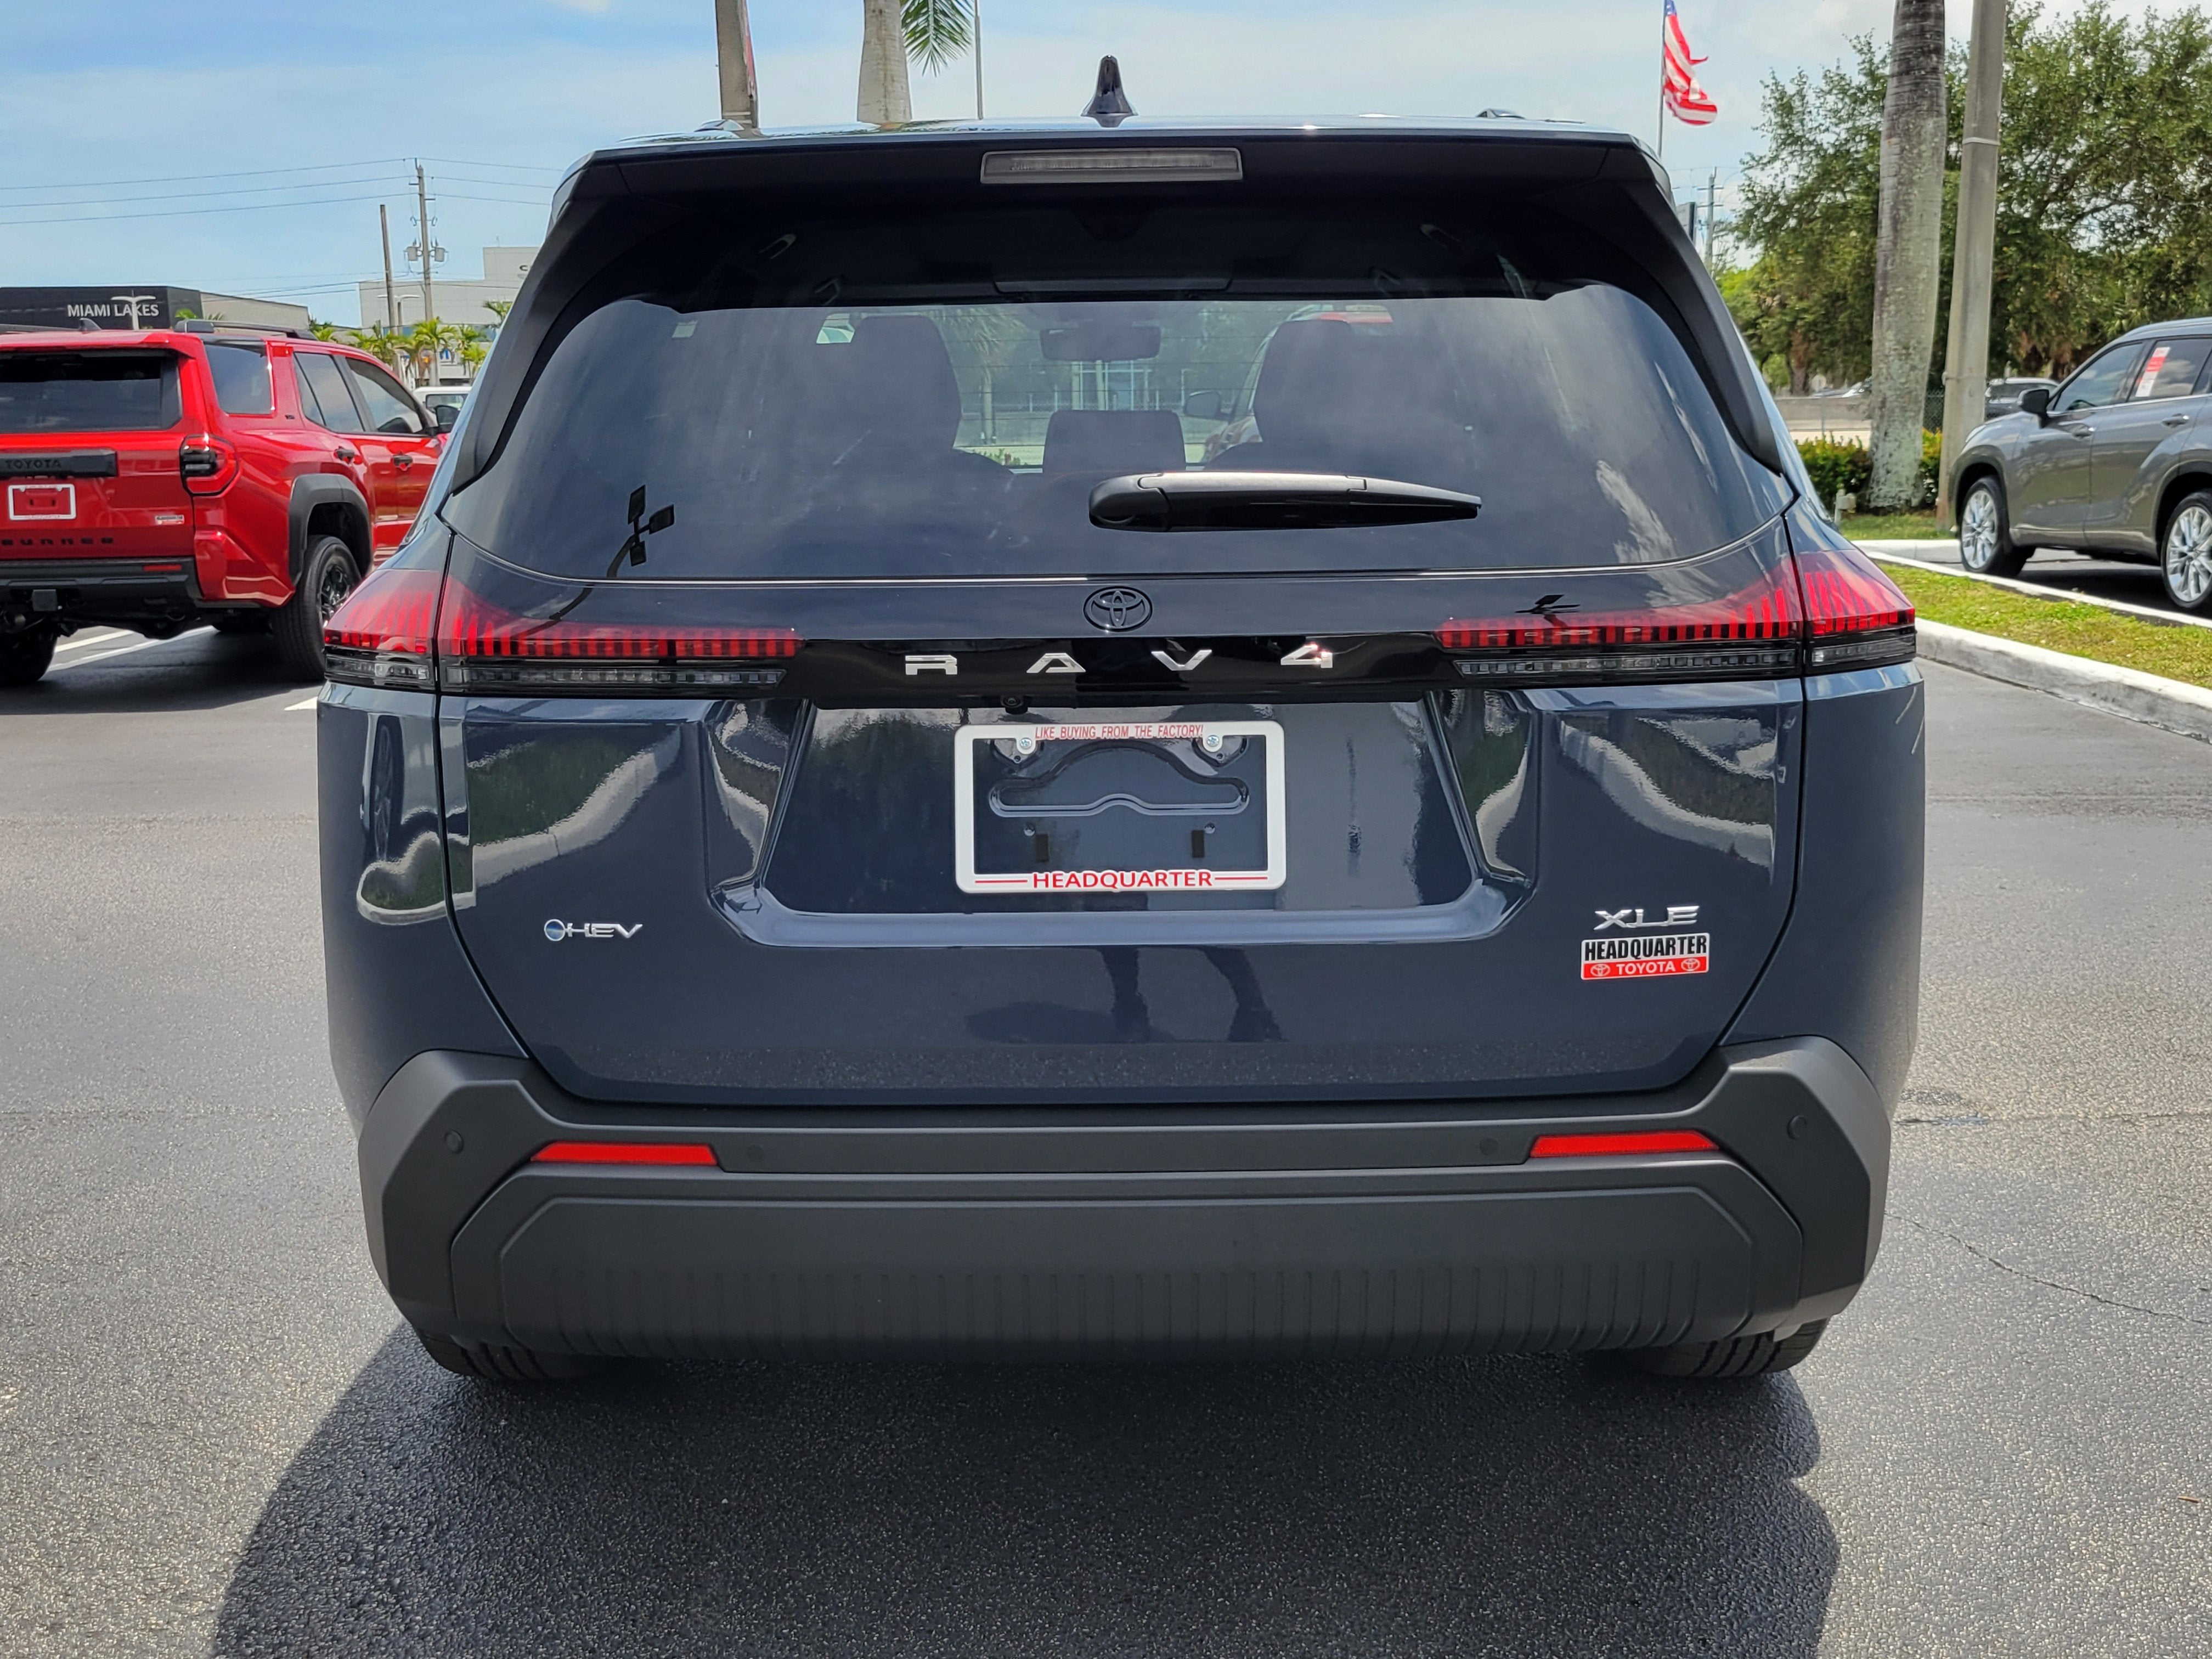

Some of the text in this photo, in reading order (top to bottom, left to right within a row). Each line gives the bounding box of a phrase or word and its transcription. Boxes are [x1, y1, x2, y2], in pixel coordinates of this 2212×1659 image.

[67, 304, 110, 317] MIAMI
[5, 459, 61, 470] TOYOTA
[1035, 724, 1204, 739] LIKE BUYING FROM THE FACTORY!
[1034, 872, 1212, 889] HEADQUARTER
[1593, 905, 1700, 930] XLE
[1584, 935, 1707, 961] HEADQUARTER
[1616, 961, 1676, 975] TOYOTA
